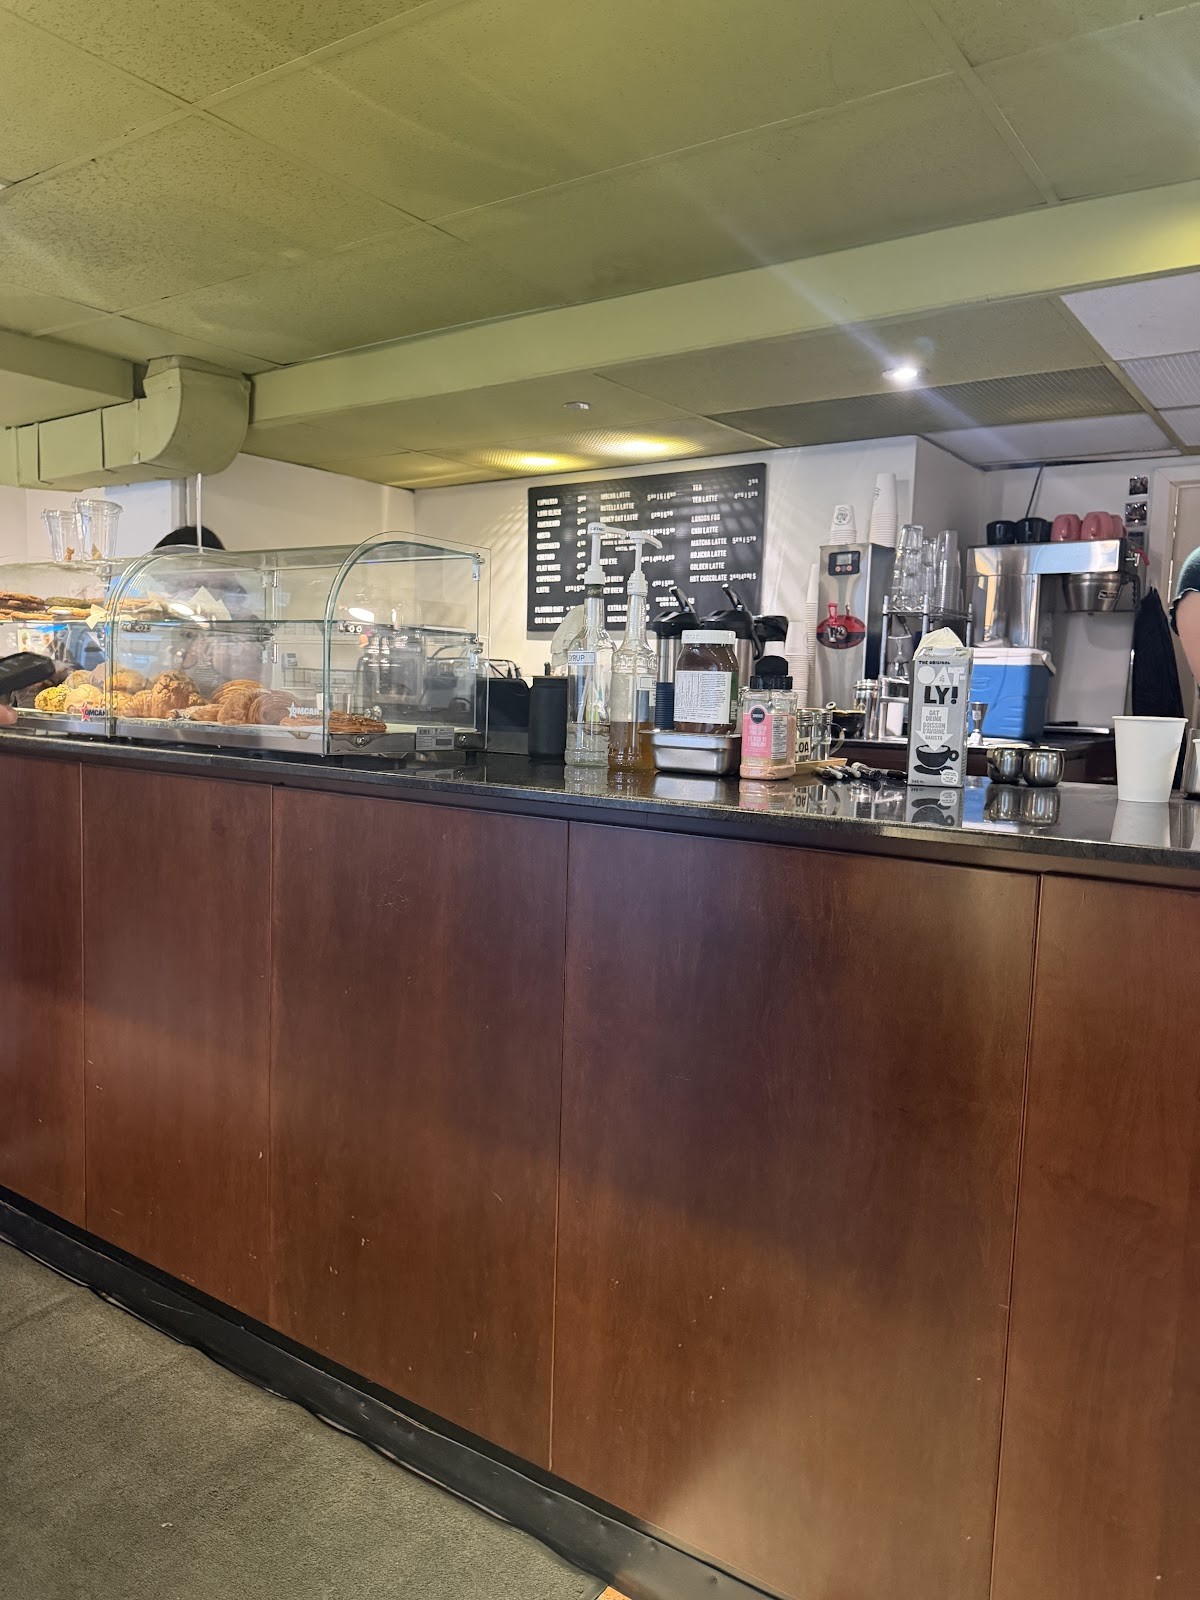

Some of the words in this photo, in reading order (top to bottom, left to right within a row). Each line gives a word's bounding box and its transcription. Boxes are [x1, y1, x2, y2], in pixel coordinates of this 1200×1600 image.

[703, 494, 718, 502] LATTE
[703, 526, 719, 534] LATTE
[691, 539, 711, 547] MATCHA
[689, 575, 699, 583] HOT
[700, 574, 727, 582] CHOCOLATE
[924, 686, 958, 705] LY!
[84, 709, 109, 717] OMCAN
[292, 707, 320, 715] OMCAN
